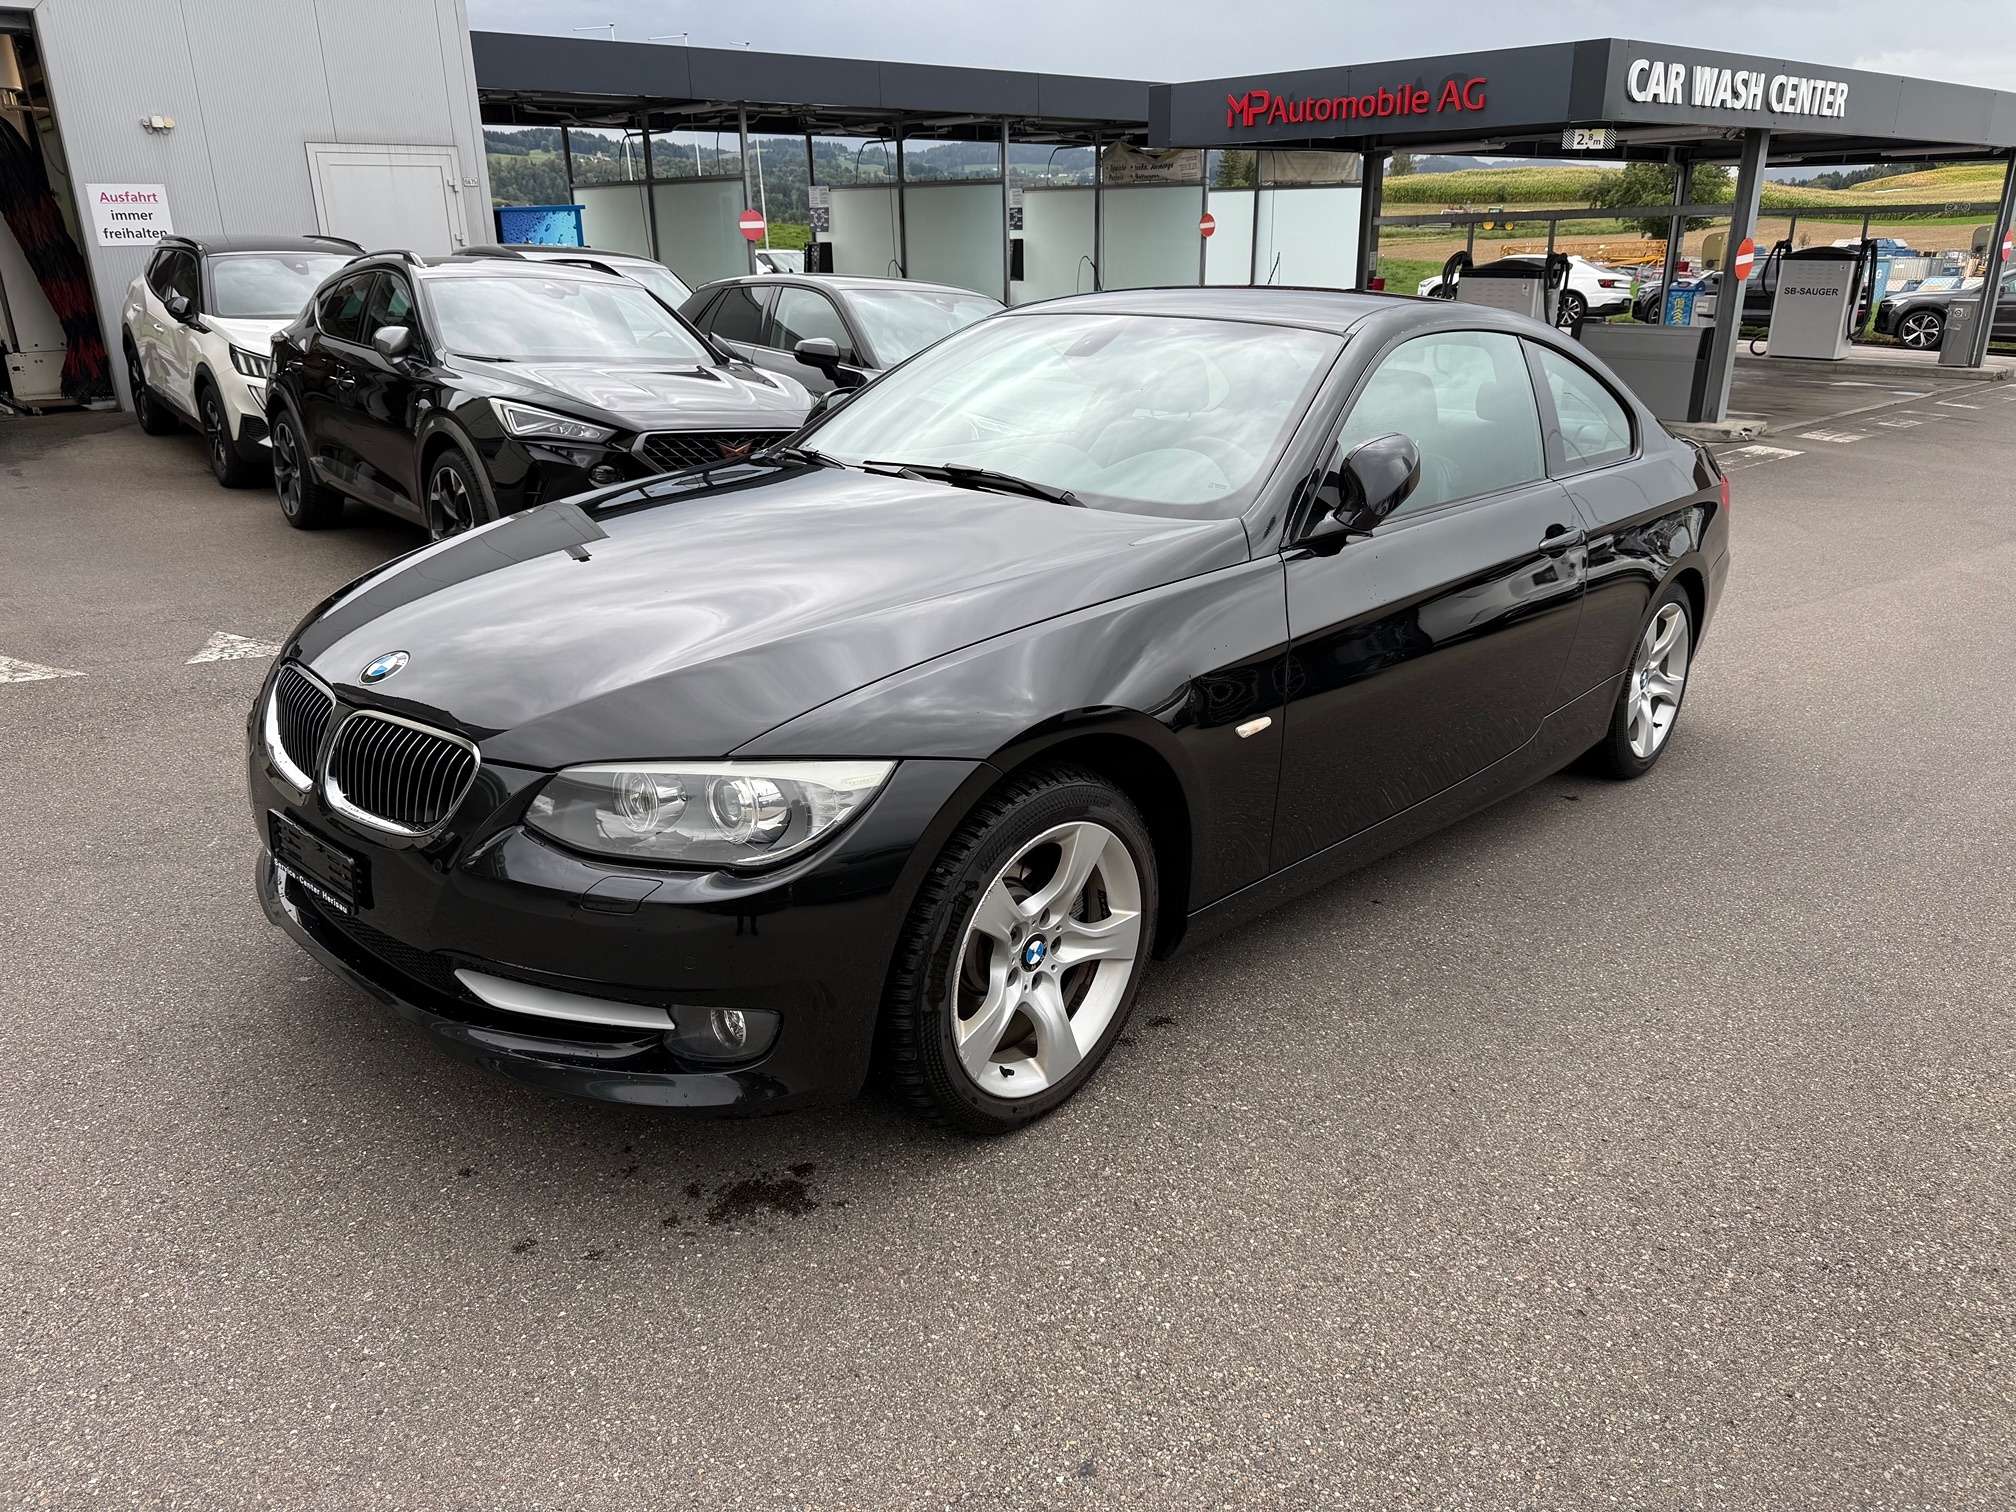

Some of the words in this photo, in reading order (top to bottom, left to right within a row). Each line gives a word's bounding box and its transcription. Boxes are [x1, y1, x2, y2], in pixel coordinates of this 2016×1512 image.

[1627, 58, 1686, 104] CAR
[1691, 65, 1766, 111] WASH
[1768, 74, 1849, 117] CENTER
[1437, 77, 1487, 112] AG
[99, 191, 158, 203] Ausfahrt
[110, 209, 153, 221] immer
[103, 227, 168, 239] freihalten
[1783, 286, 1839, 297] SB-SAUGER
[322, 890, 348, 914] Herisau
